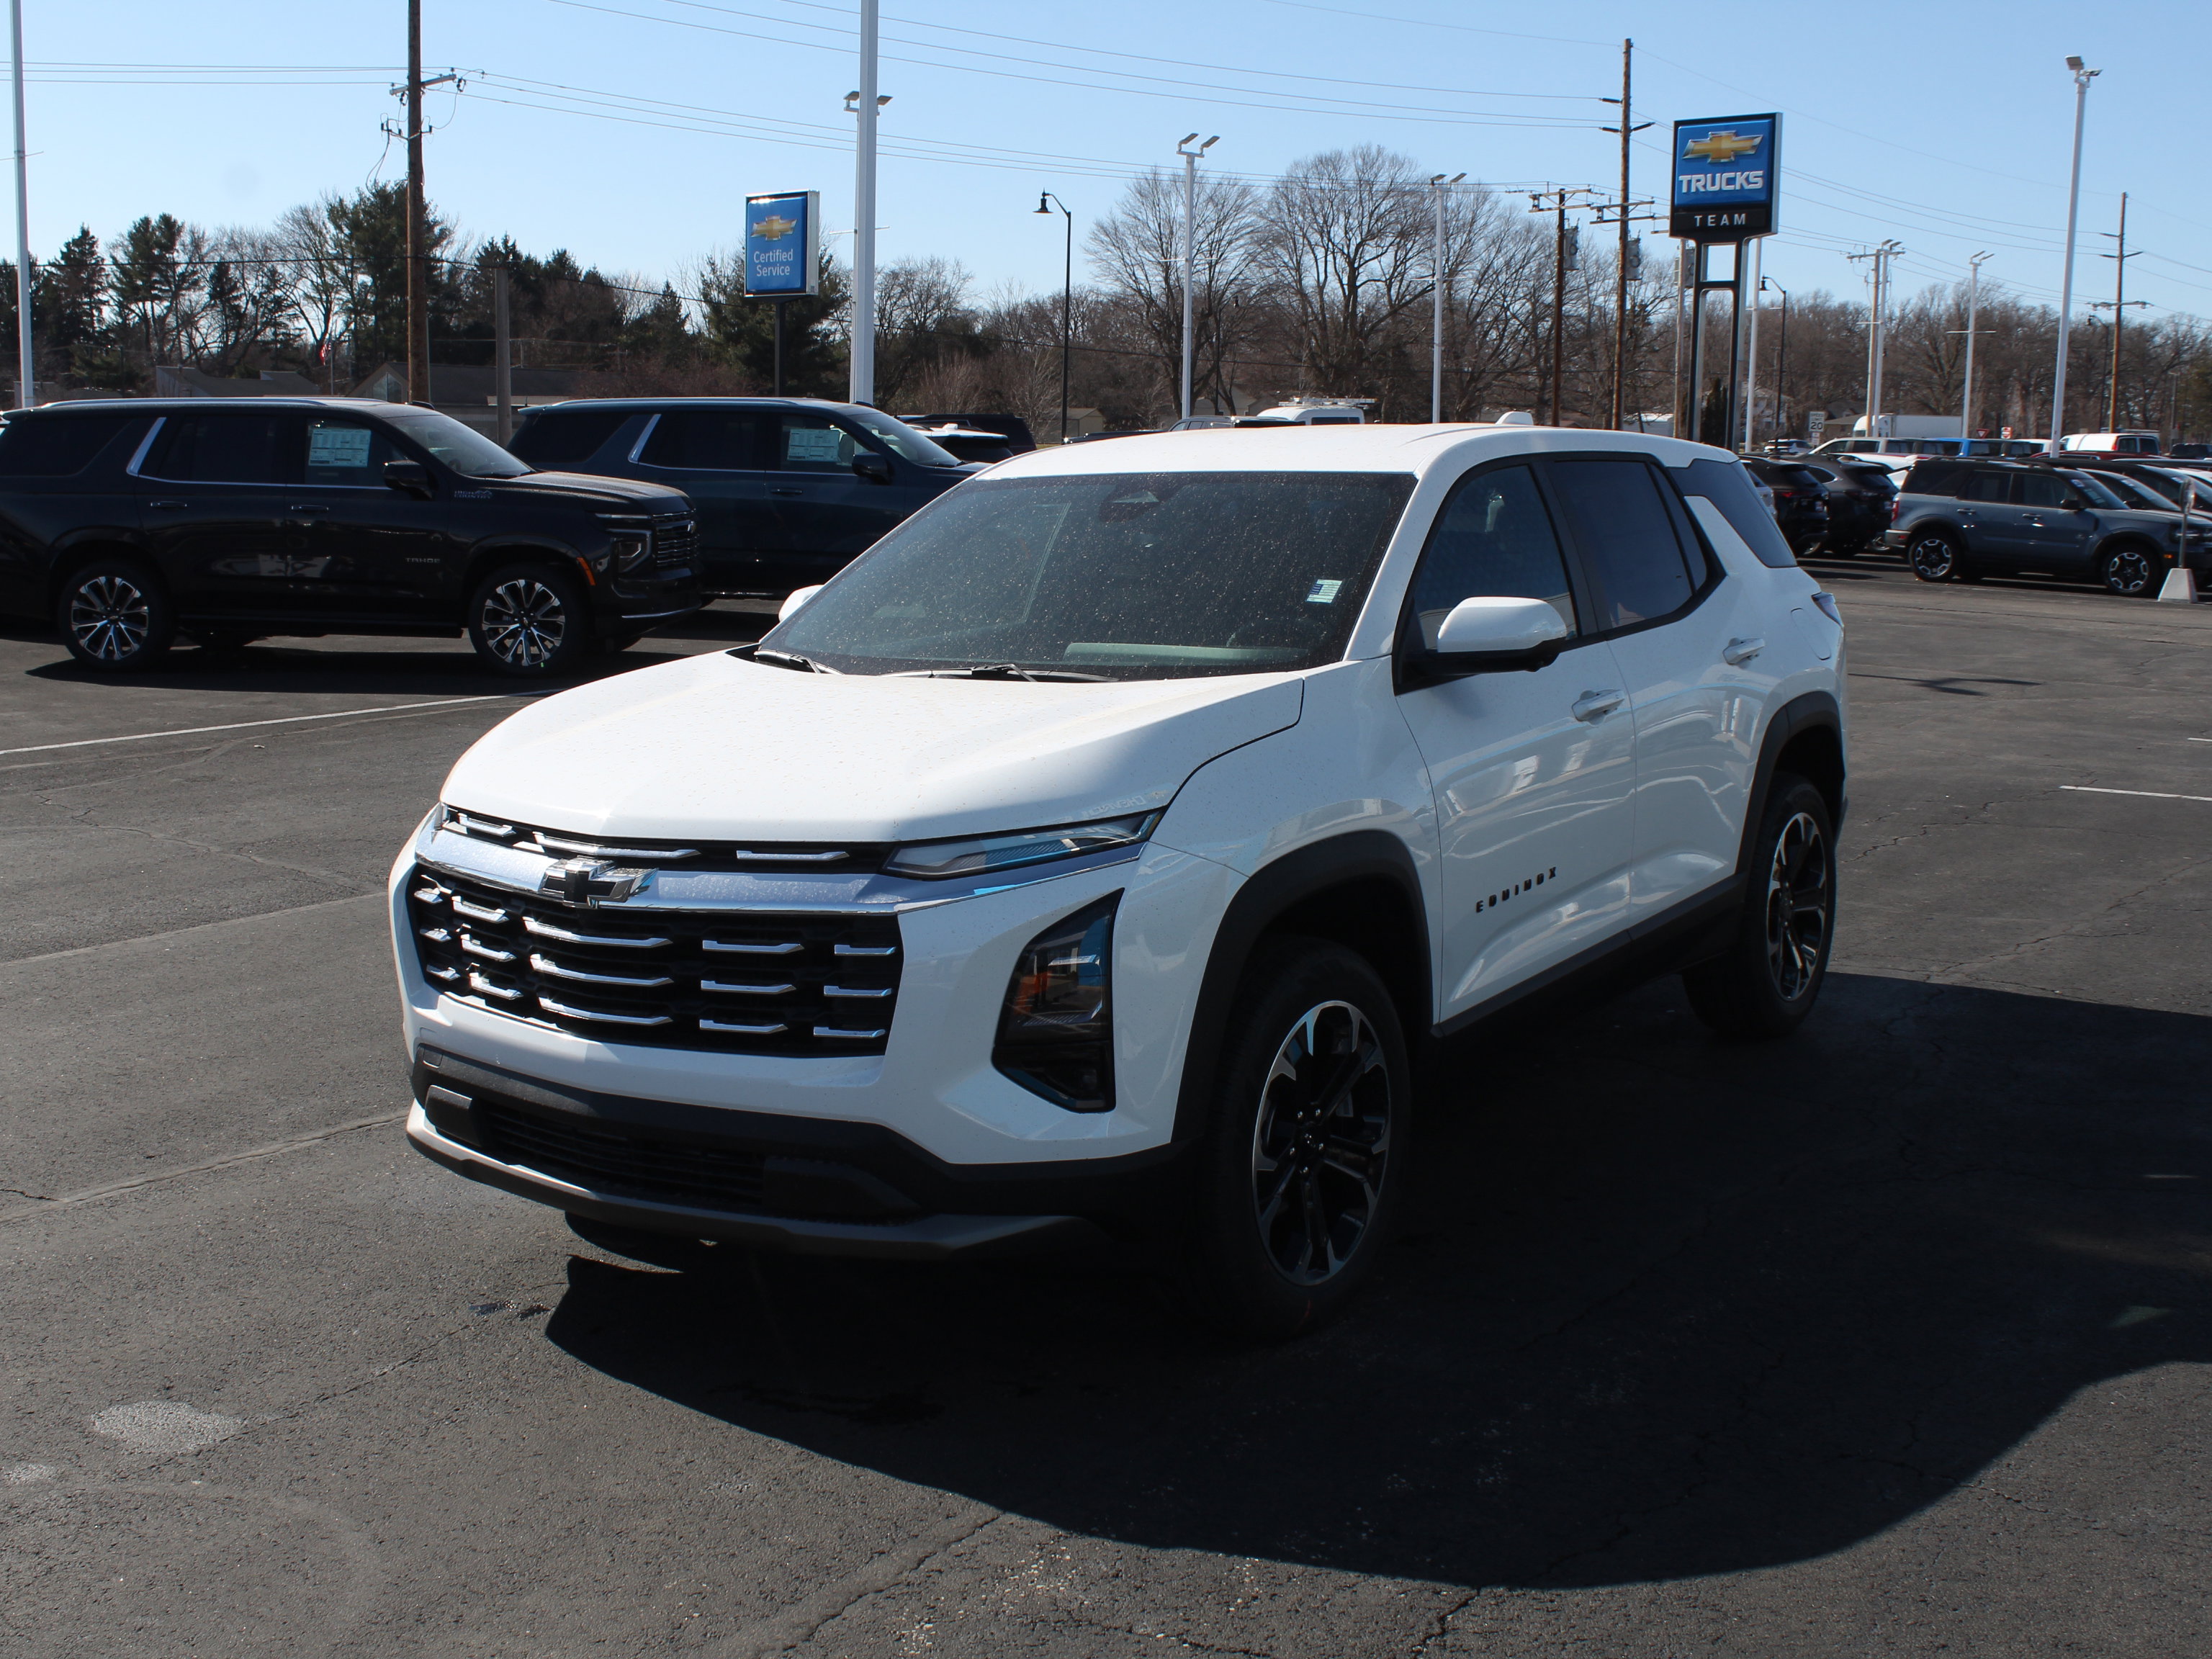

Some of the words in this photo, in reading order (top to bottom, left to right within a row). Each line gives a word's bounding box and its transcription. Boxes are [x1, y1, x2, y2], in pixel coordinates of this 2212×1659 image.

[1678, 171, 1763, 193] TRUCKS
[1694, 213, 1746, 227] TEAM
[754, 248, 793, 263] Certified
[756, 264, 791, 276] Service
[1810, 421, 1823, 430] 20
[1476, 866, 1557, 913] EQUINOX
